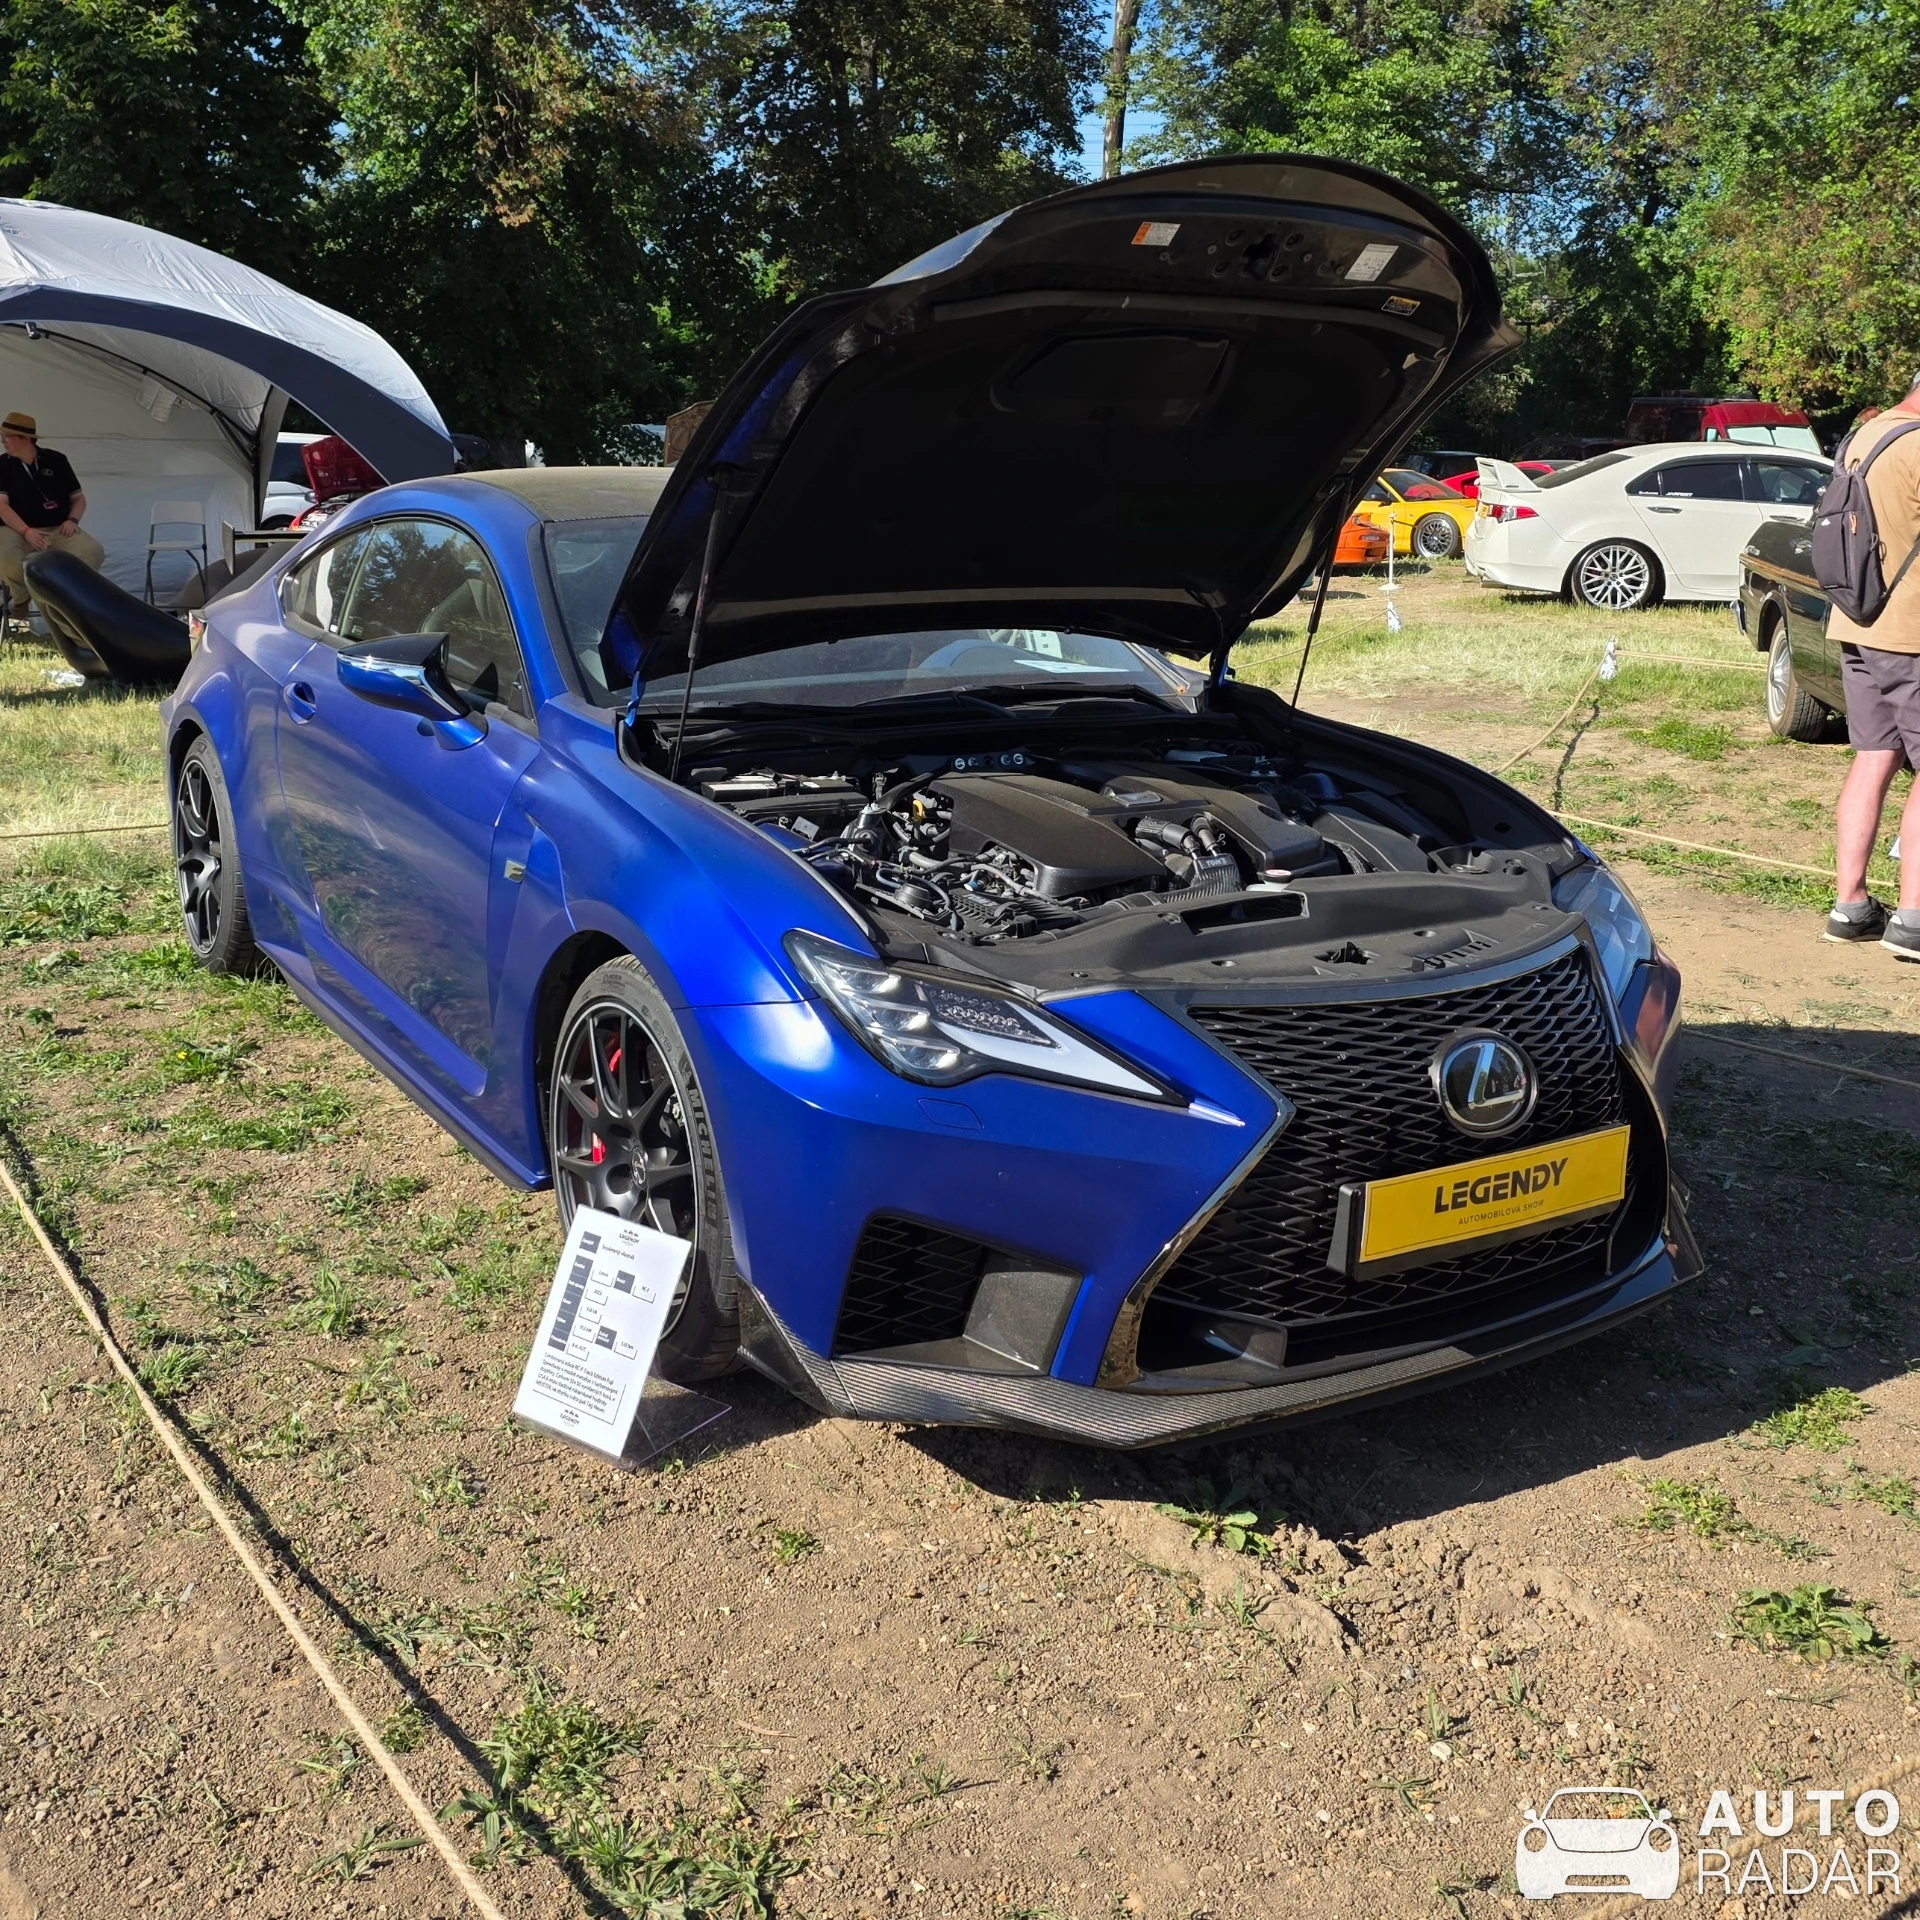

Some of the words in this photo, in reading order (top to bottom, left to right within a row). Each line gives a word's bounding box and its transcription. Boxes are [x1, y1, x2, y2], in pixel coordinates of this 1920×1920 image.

[688, 1089, 719, 1224] MICHELIN
[1433, 1157, 1569, 1214] LEGENDY
[1457, 1203, 1522, 1226] AUTOMOBILOVÁ
[1522, 1199, 1545, 1214] SHOW
